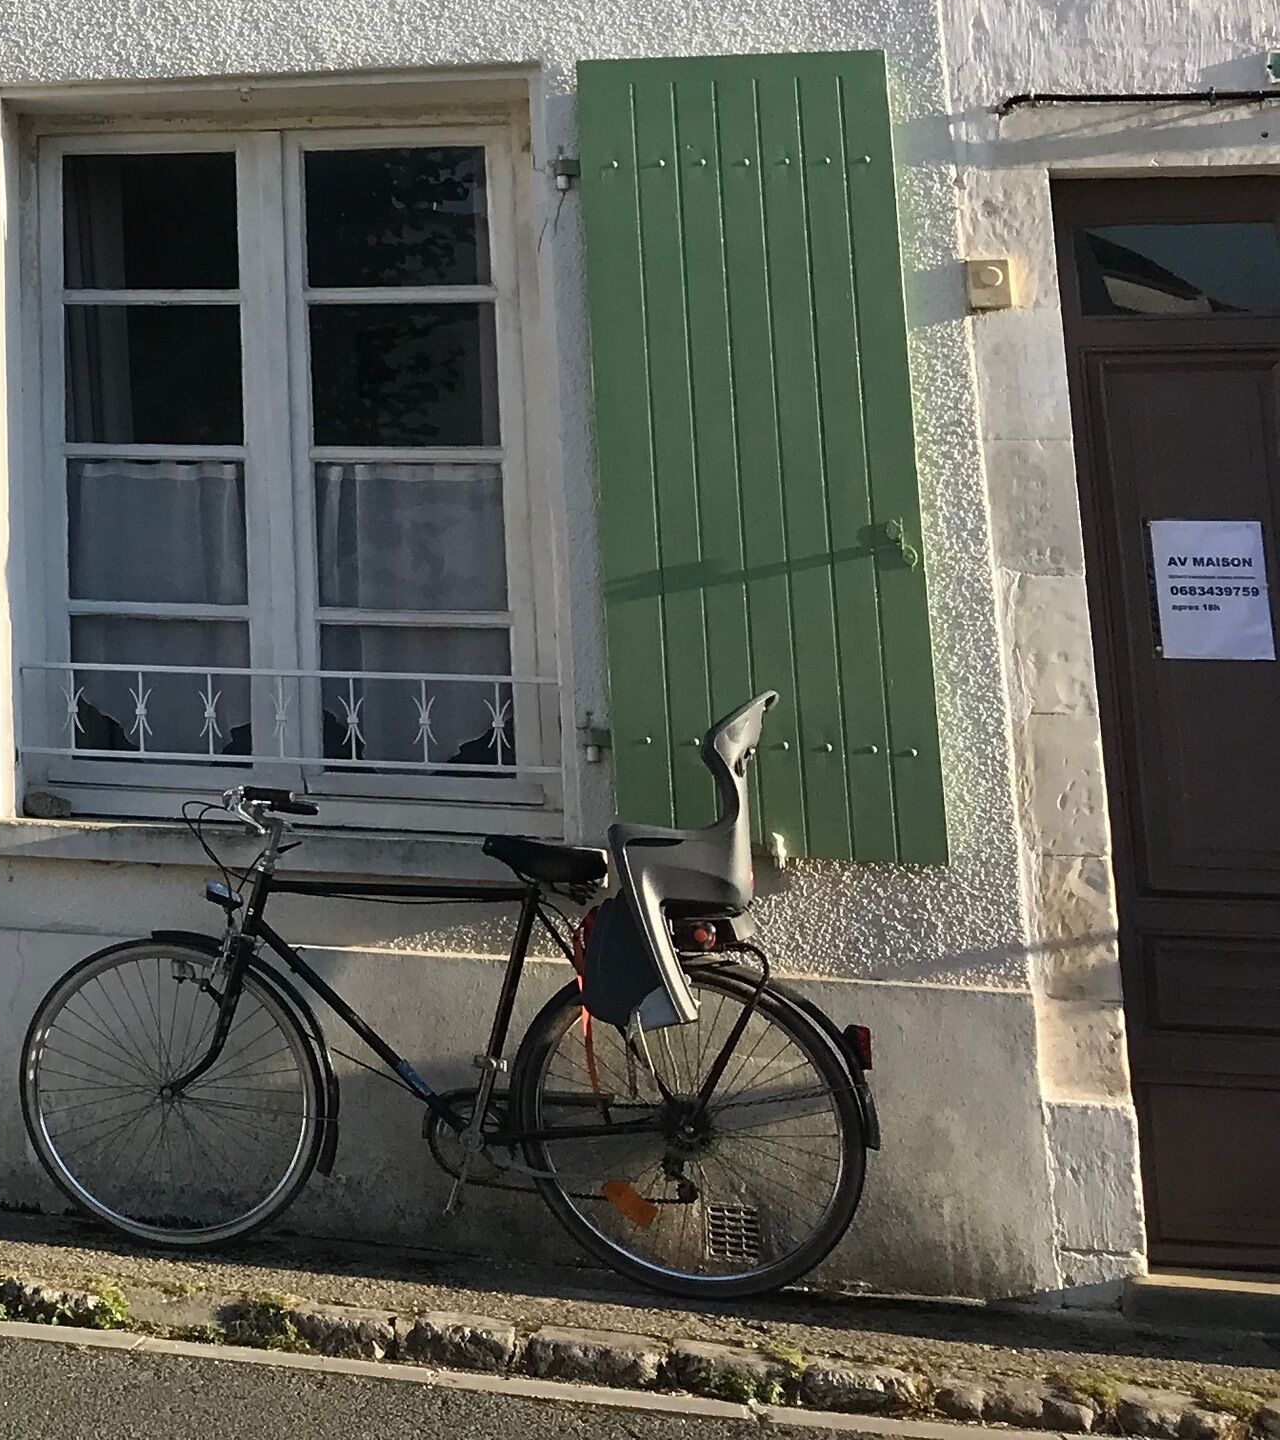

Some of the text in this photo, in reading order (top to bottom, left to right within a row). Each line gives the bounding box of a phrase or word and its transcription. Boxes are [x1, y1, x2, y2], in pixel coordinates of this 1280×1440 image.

[1168, 556, 1253, 567] AV MAISON
[1170, 585, 1260, 597] 0683439759
